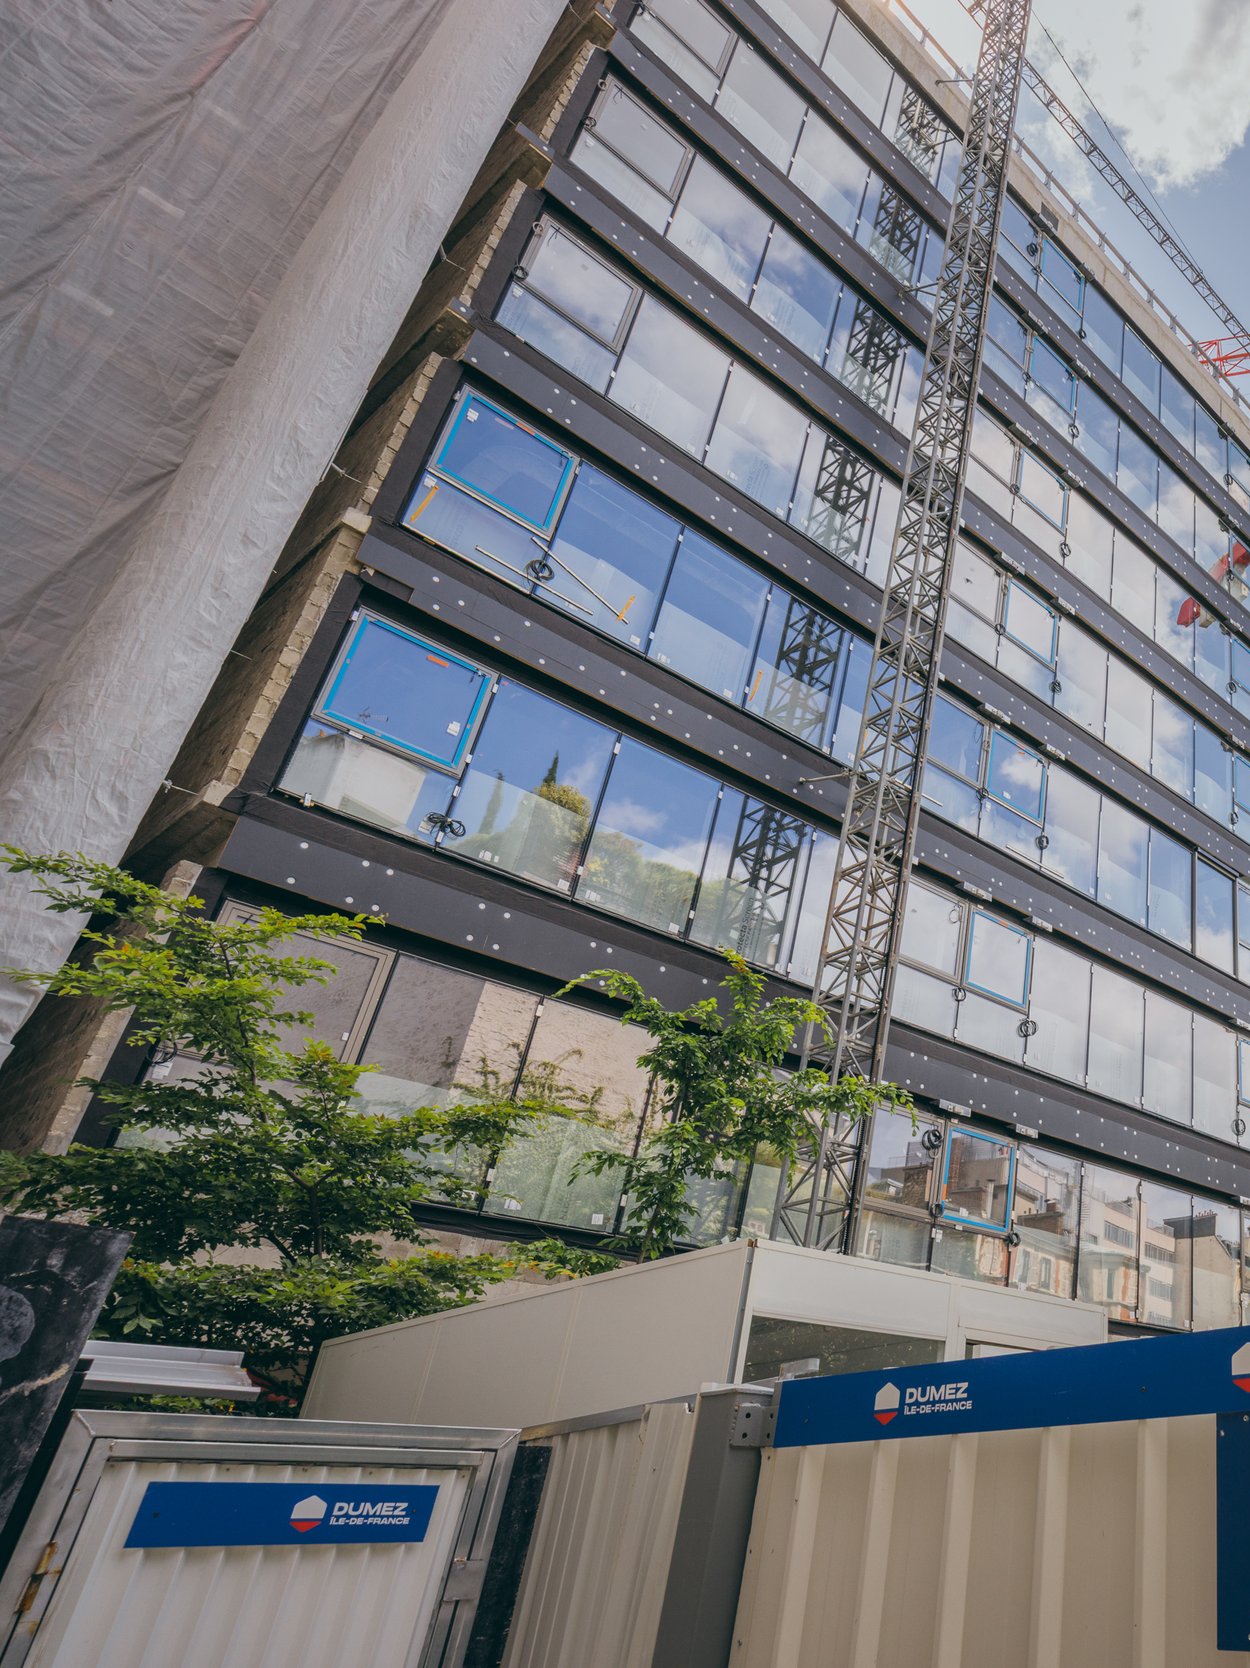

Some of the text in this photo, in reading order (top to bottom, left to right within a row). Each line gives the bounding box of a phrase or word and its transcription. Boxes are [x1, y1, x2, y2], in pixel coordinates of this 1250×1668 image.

[905, 1382, 968, 1403] DUMEZ
[904, 1401, 972, 1415] ÎLE-DE-FRANCE
[332, 1502, 408, 1515] DUMEZ
[329, 1516, 410, 1525] ÎLE-DE-FRANCE
